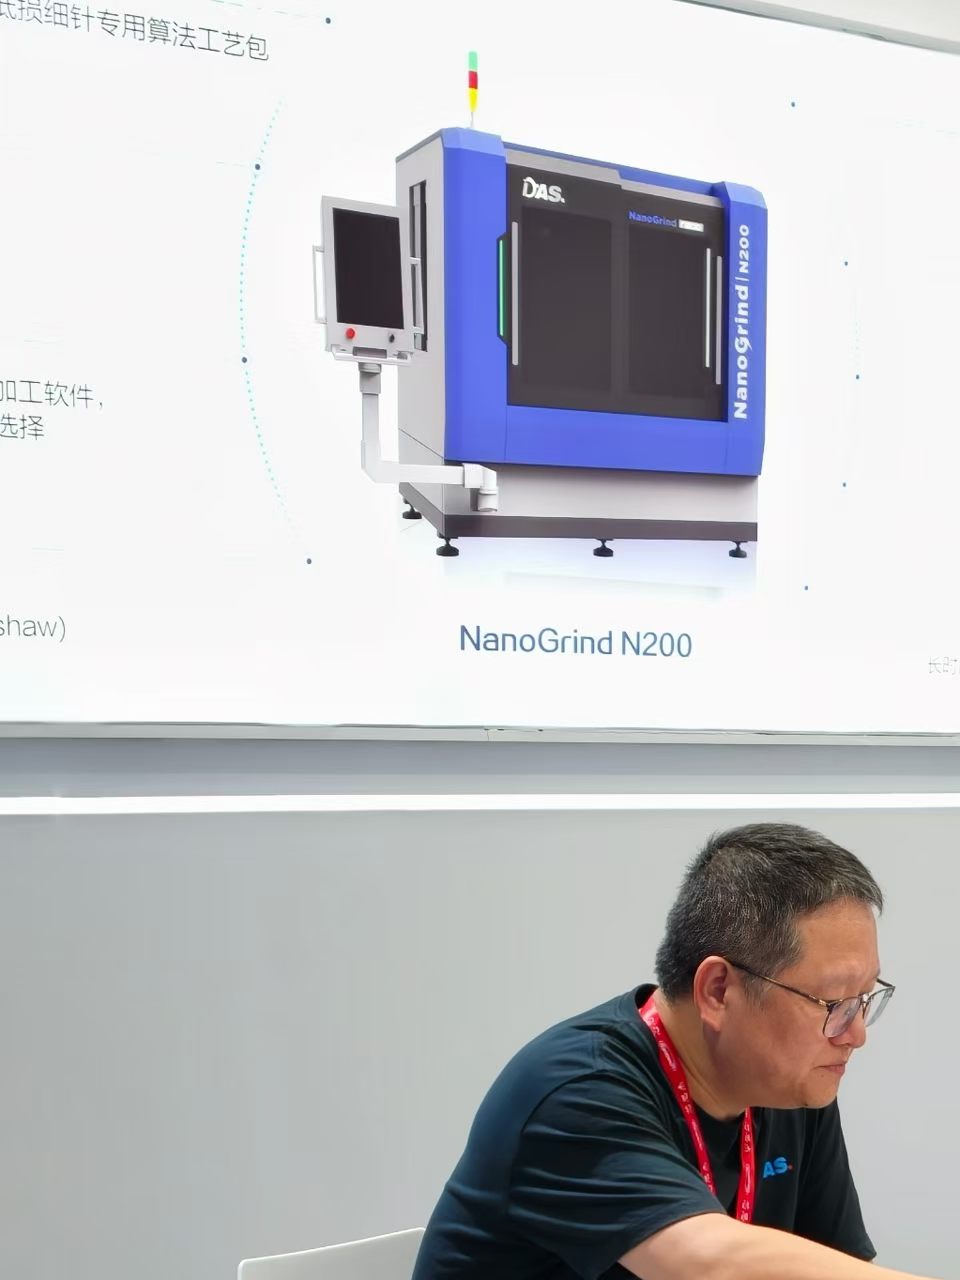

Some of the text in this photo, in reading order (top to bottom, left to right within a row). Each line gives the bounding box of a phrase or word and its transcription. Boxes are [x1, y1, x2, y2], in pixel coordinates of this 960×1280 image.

[628, 211, 677, 228] NanoGrind
[734, 224, 752, 420] NanoGrind N200
[459, 624, 693, 658] NanoGrind N200
